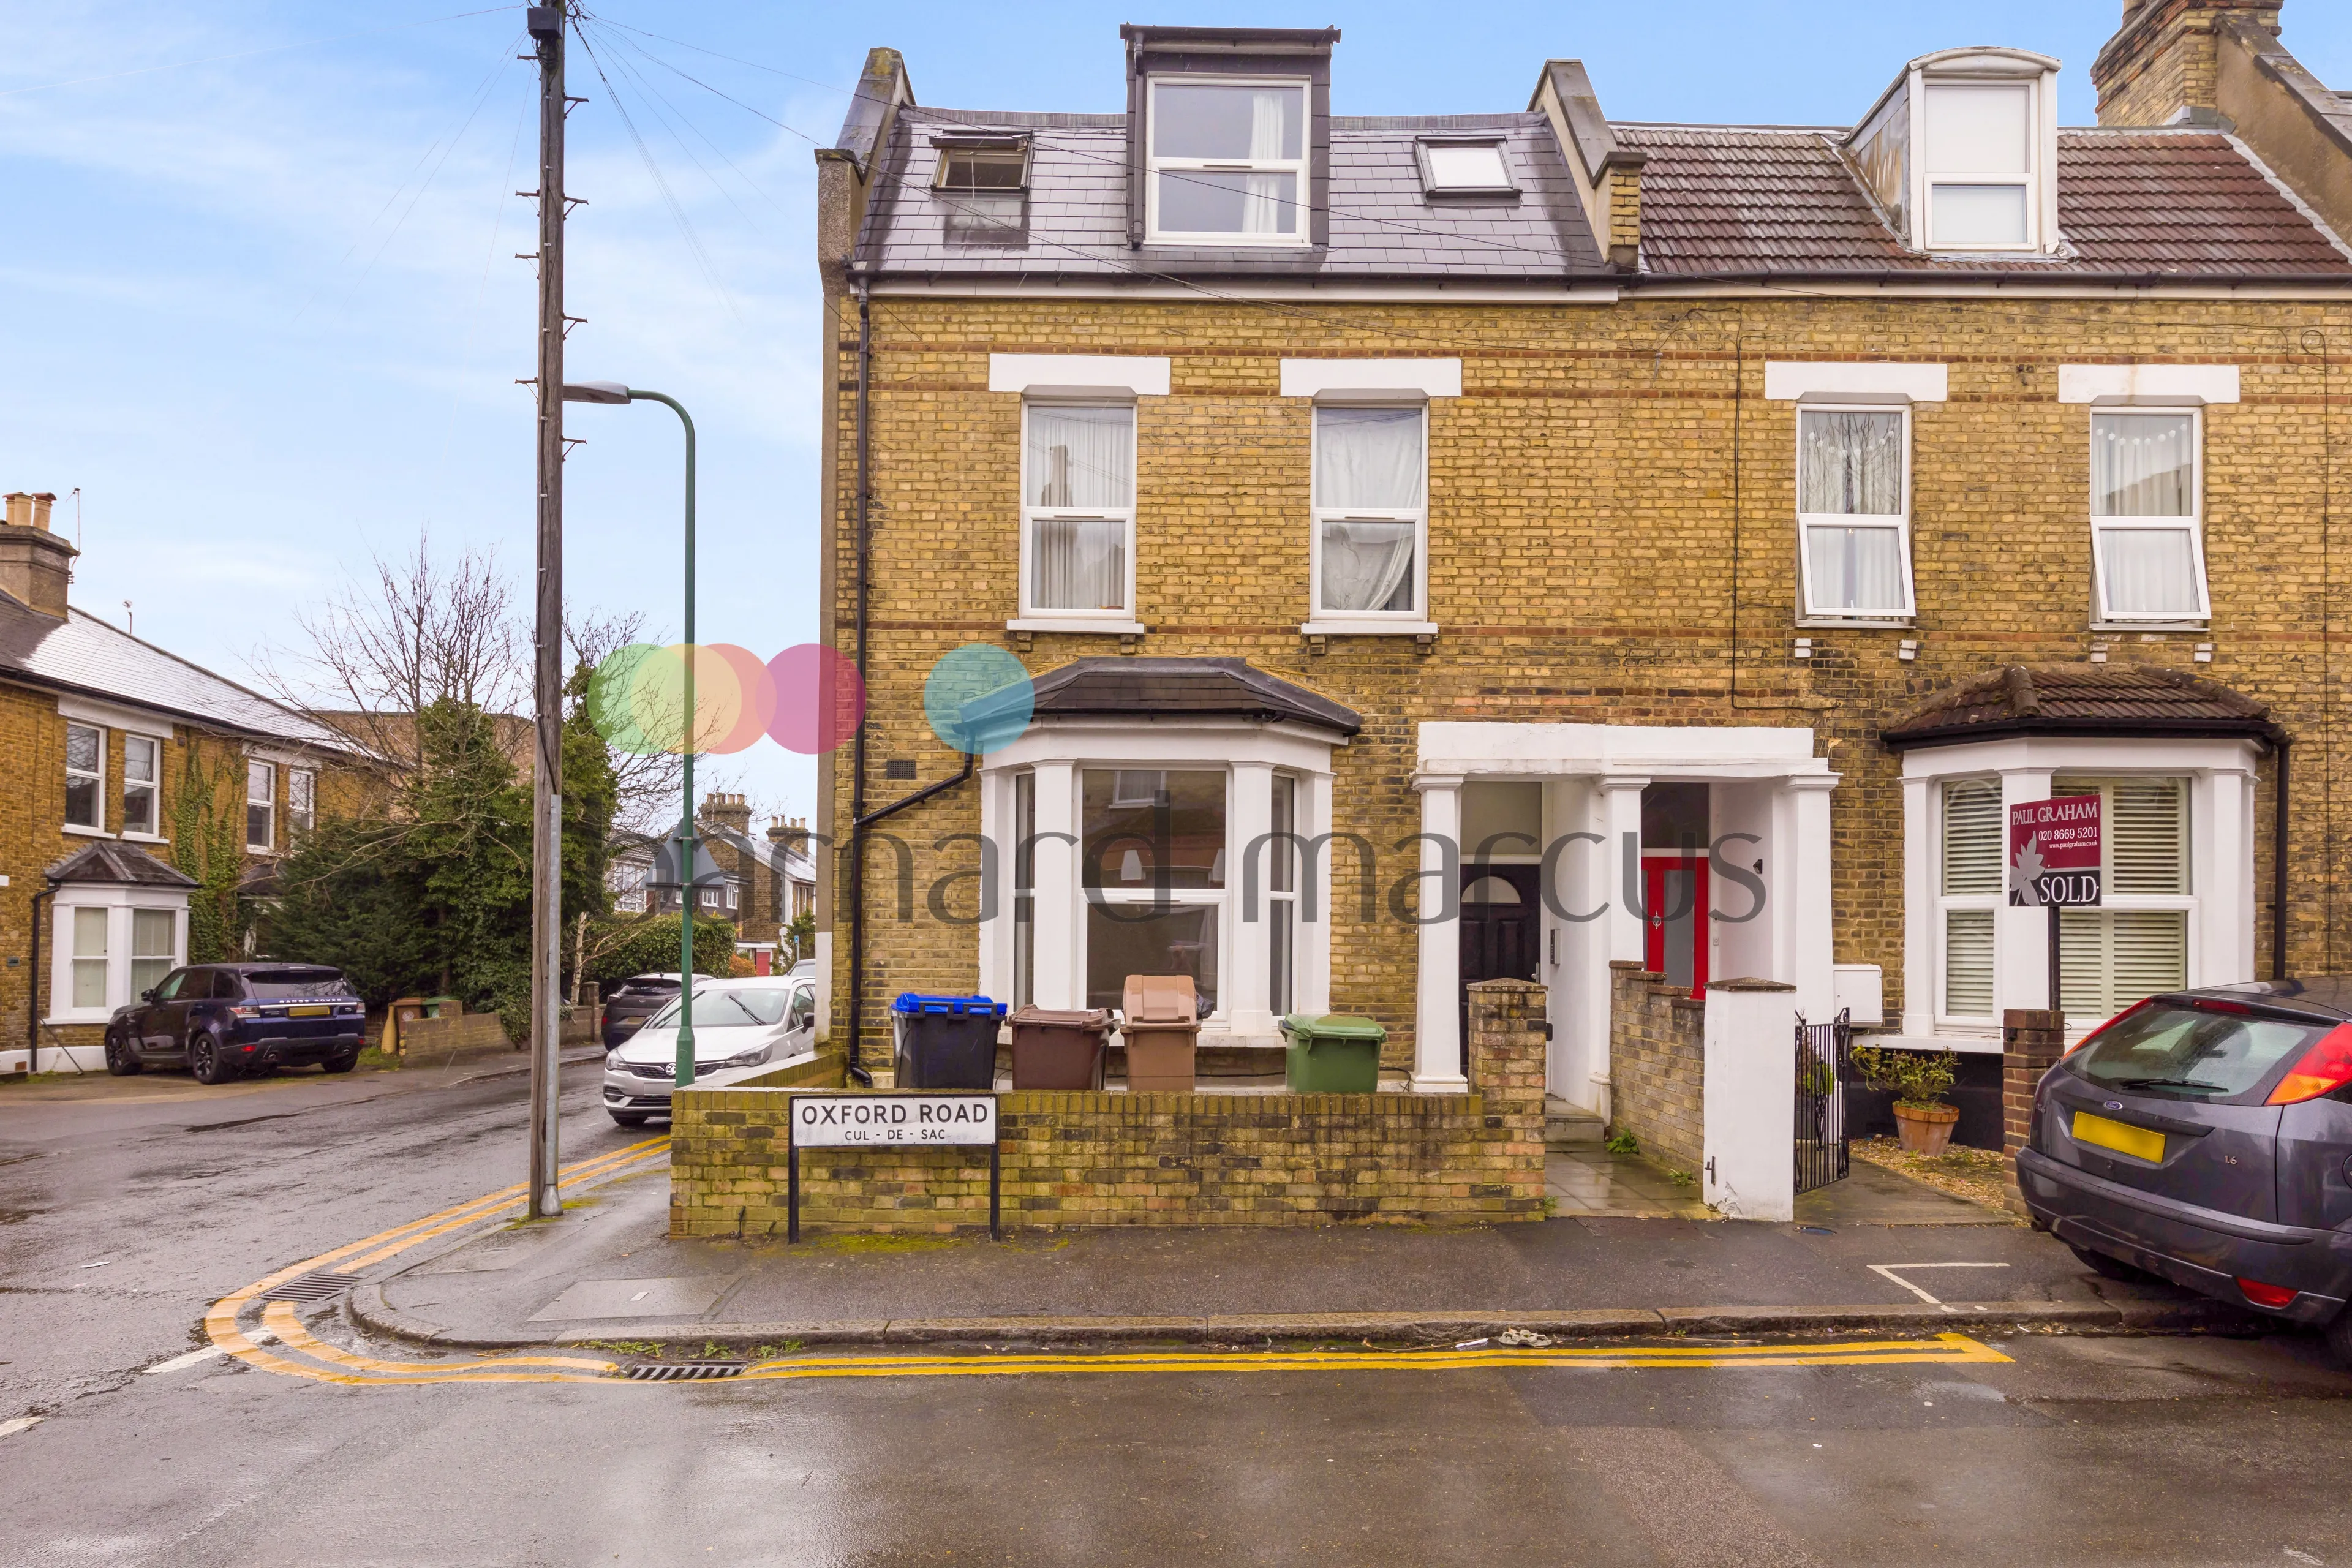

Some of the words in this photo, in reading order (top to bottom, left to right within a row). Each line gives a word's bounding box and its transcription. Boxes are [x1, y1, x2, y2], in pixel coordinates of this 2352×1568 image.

[2011, 809, 2036, 826] PAUL
[2037, 802, 2098, 823] GRAHAM
[2038, 830, 2052, 841] 020
[2054, 828, 2075, 840] 8669
[2077, 827, 2097, 839] 5201
[2049, 840, 2098, 850] www.paulgraham.co.uk
[2040, 876, 2097, 903] SOLD
[802, 1104, 907, 1125] OXFORD
[919, 1104, 988, 1123] ROAD
[845, 1130, 870, 1140] CUL
[887, 1129, 903, 1140] DE
[921, 1129, 946, 1139] SAC
[2224, 1155, 2237, 1164] 1.6
